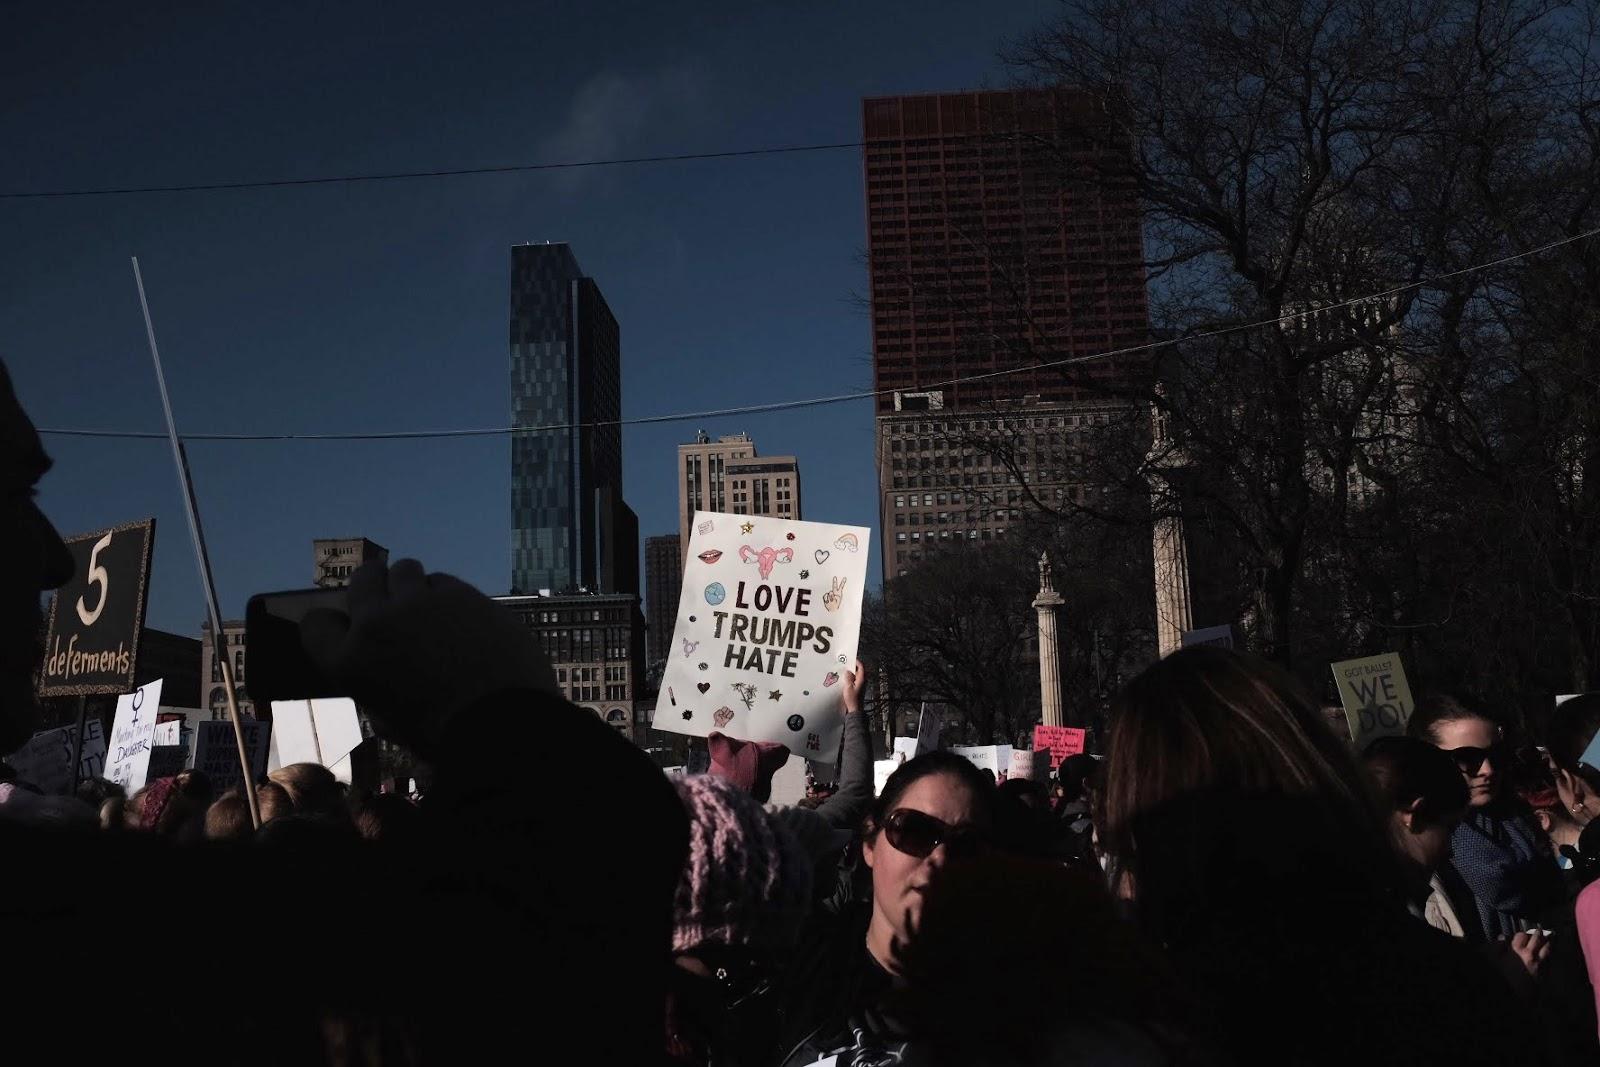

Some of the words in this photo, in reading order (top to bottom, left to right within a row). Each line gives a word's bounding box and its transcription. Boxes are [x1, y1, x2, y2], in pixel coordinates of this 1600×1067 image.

[76, 528, 113, 626] 5
[735, 581, 812, 617] LOVE
[713, 611, 834, 654] TRUMPS
[48, 633, 130, 680] deferments
[723, 644, 799, 678] HATE
[1344, 667, 1364, 678] GOT
[1365, 661, 1393, 674] BALLS?
[1349, 674, 1397, 704] WE
[1356, 702, 1408, 734] DO!
